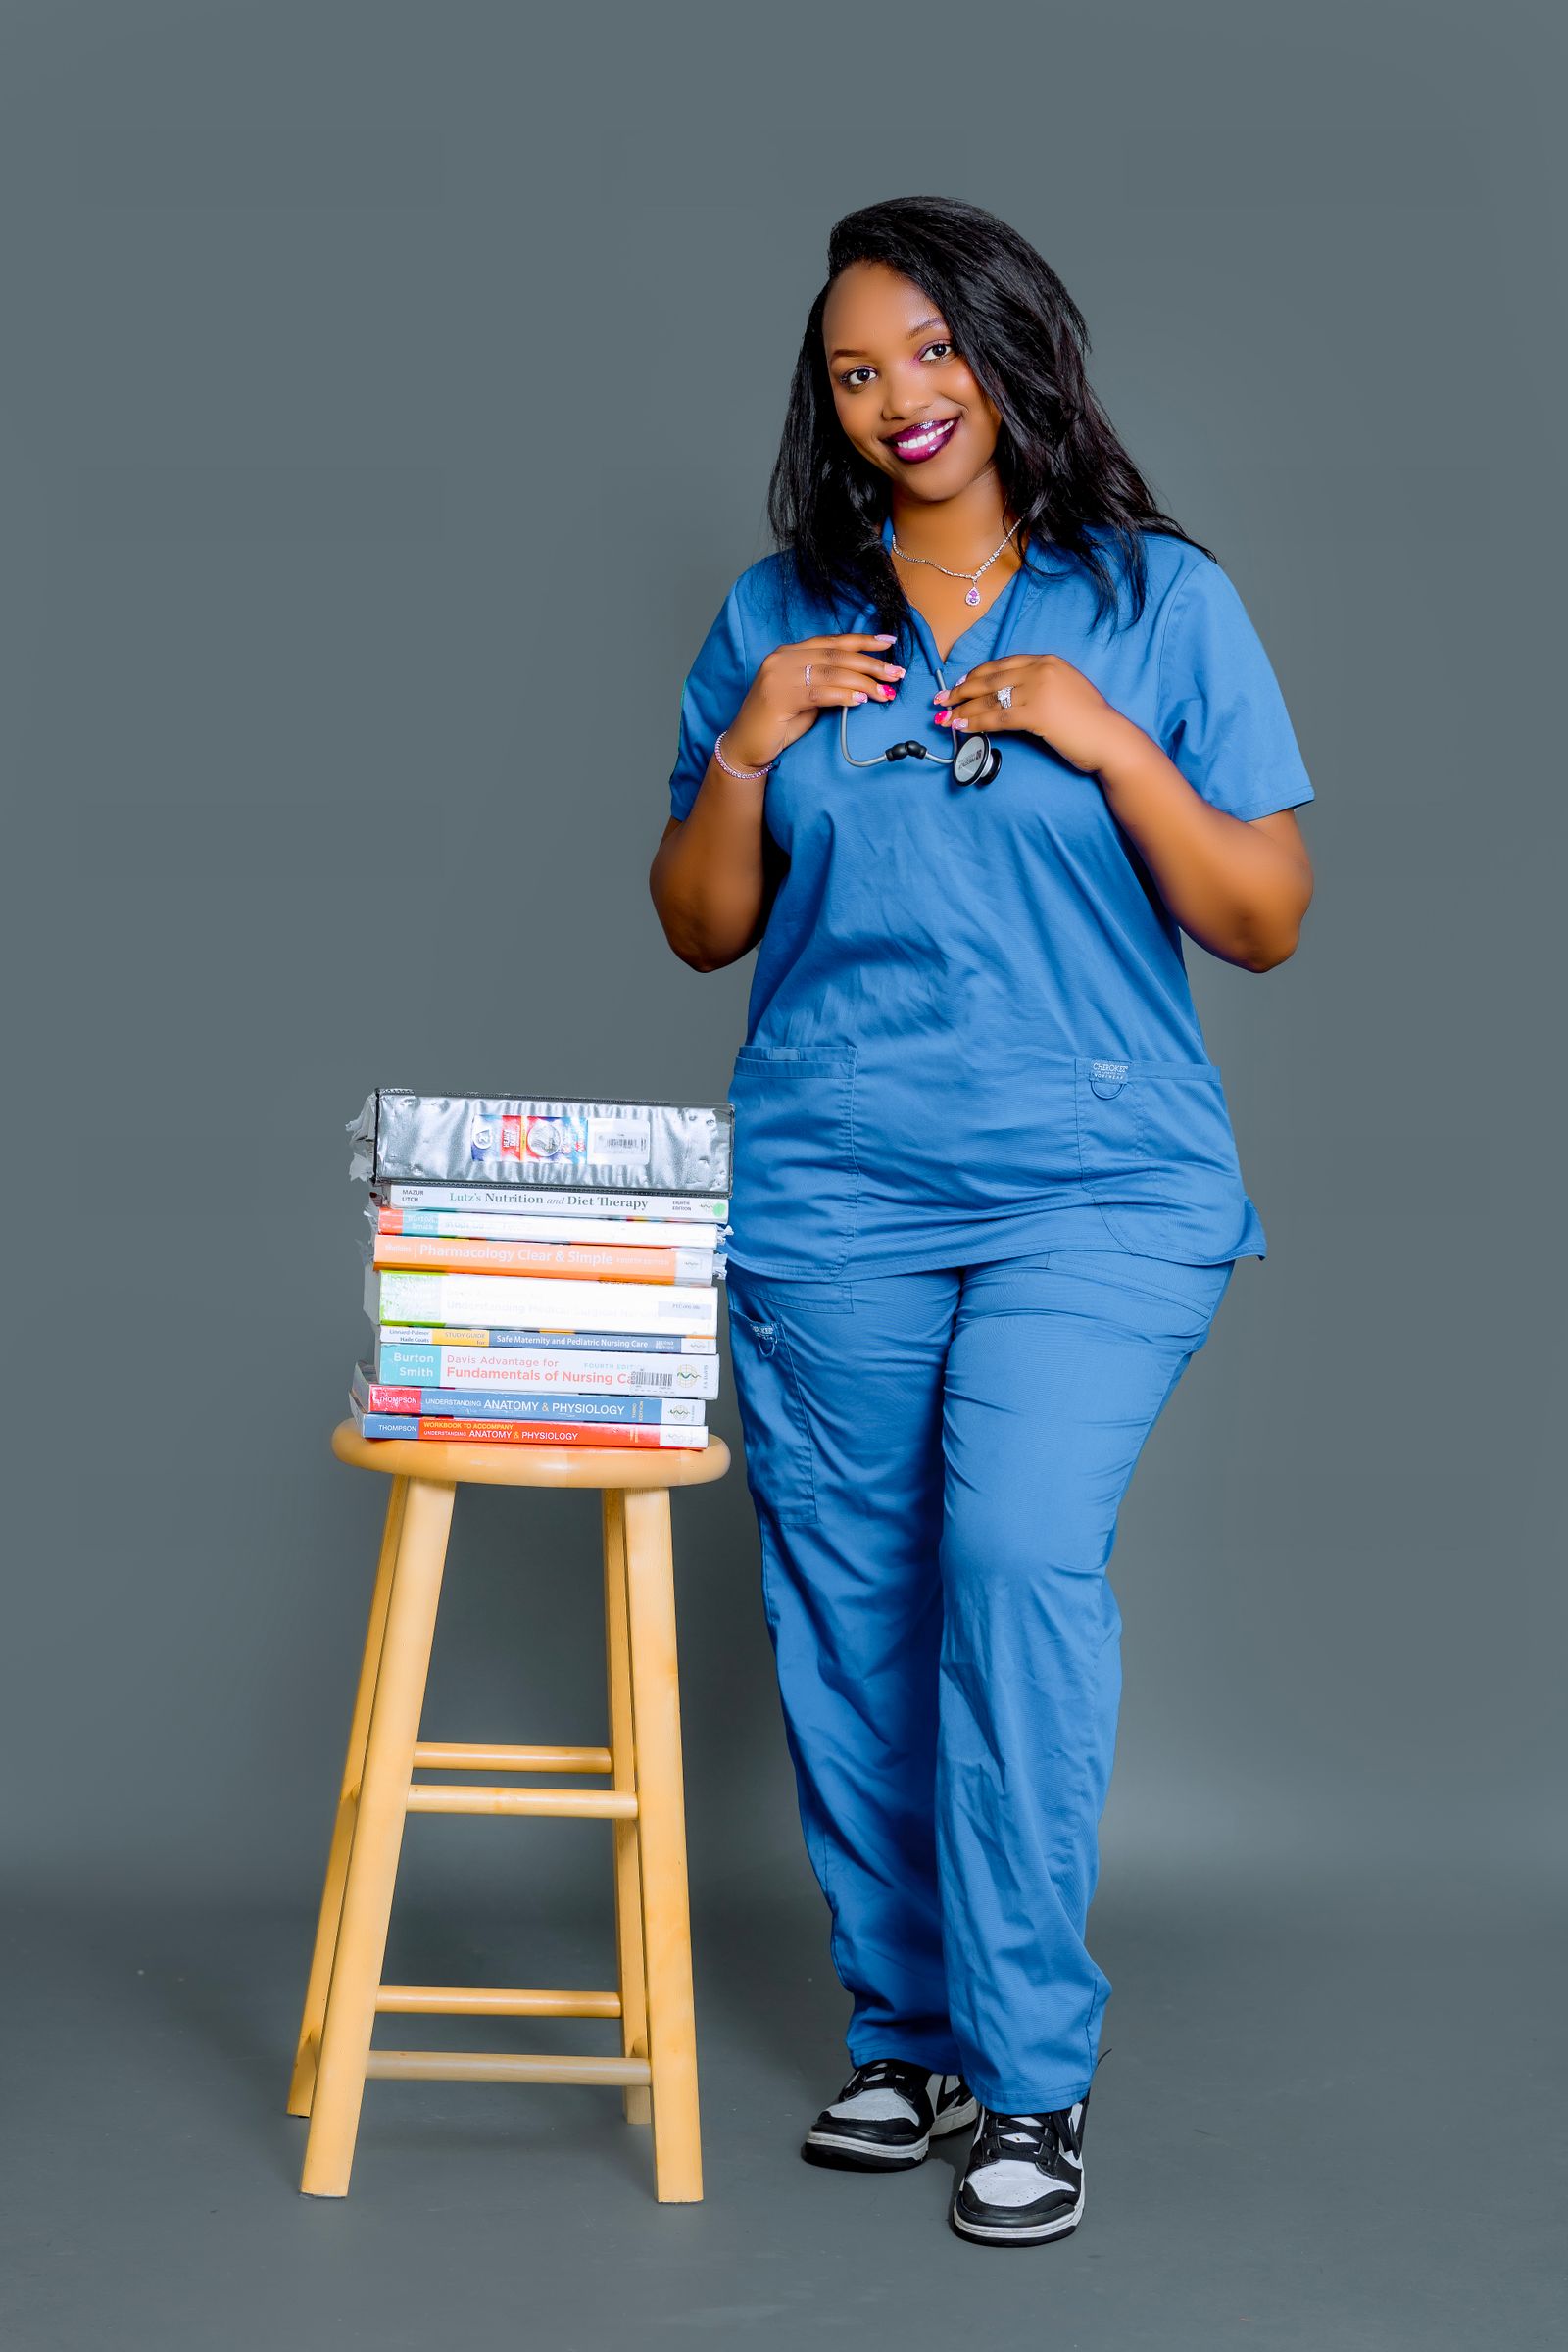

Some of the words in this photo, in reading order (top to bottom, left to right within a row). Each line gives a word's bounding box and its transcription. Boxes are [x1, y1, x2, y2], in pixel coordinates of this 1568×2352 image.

[485, 1193, 543, 1204] Nutrition
[567, 1196, 593, 1206] Diet
[597, 1197, 649, 1211] Therapy
[419, 1244, 514, 1262] Pharmacology
[517, 1249, 552, 1262] Clear
[555, 1250, 564, 1263] &
[567, 1252, 613, 1268] Simple
[496, 1335, 514, 1344] Safe
[514, 1336, 551, 1347] Maternity
[551, 1337, 566, 1346] and
[567, 1338, 600, 1347] Pediatric
[602, 1339, 630, 1349] Nursing
[394, 1352, 434, 1363] Burton
[447, 1354, 476, 1364] Davis
[480, 1356, 539, 1368] Advantage
[543, 1358, 559, 1368] for
[400, 1366, 433, 1377] Smith
[447, 1367, 541, 1381] Fundamentals
[545, 1370, 559, 1381] of
[563, 1372, 613, 1386] Nursing
[617, 1373, 632, 1384] Ca
[379, 1396, 417, 1405] THOMPSON
[425, 1397, 482, 1407] UNDERSTANDING
[484, 1399, 539, 1411] ANATOMY
[542, 1402, 549, 1413] &
[553, 1402, 625, 1416] PHYSIOLOGY
[468, 1430, 512, 1439] ANATOMY
[521, 1431, 578, 1441] PHYSIOLOGY
